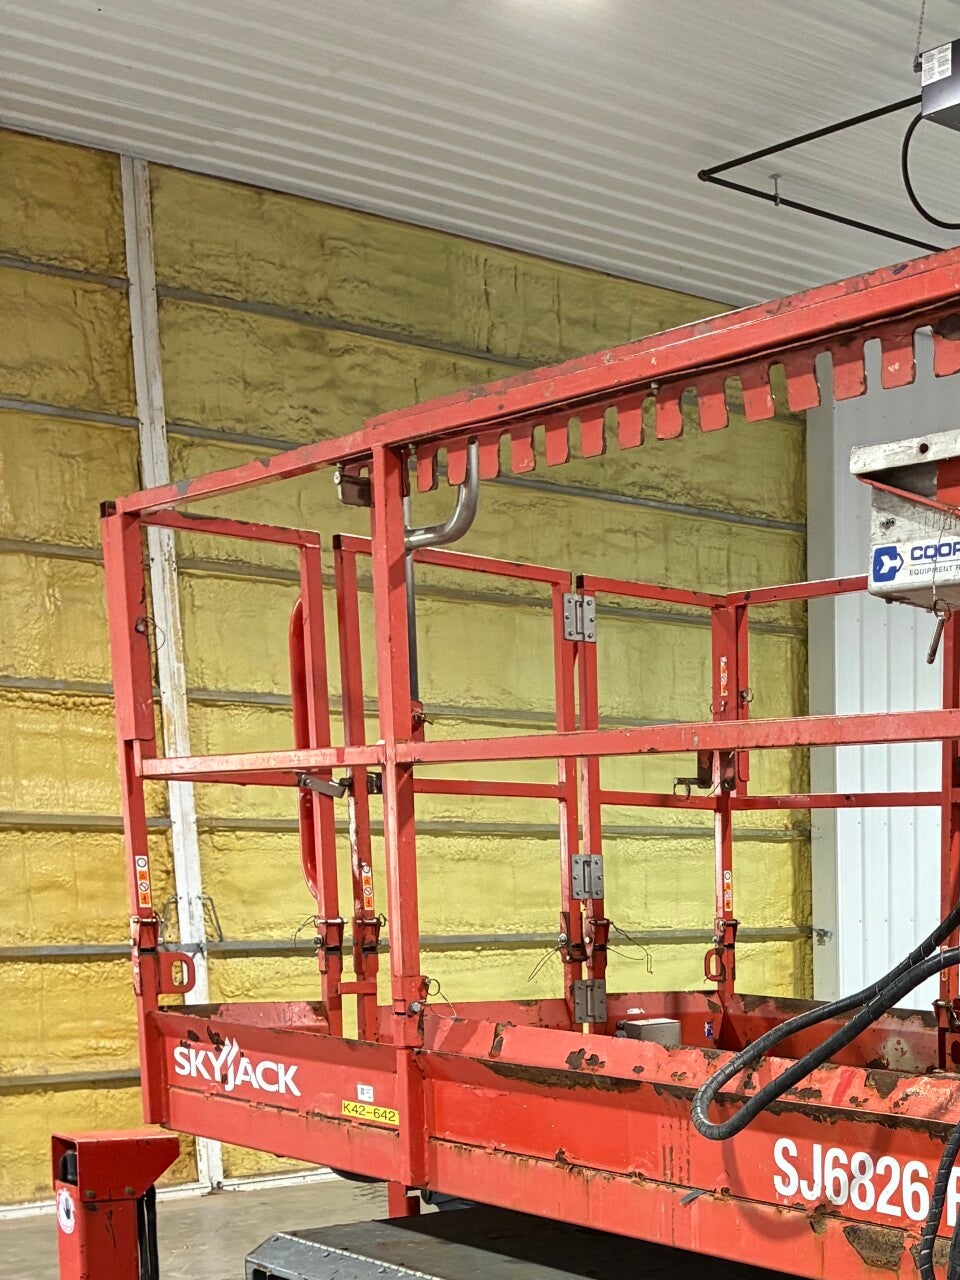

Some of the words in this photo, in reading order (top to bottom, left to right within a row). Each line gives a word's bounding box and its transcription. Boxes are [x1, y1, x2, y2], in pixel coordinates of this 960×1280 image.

[909, 565, 953, 577] EQUIPMENT
[173, 1037, 302, 1097] SKYJACK
[342, 1102, 397, 1122] K42-642
[773, 1137, 930, 1222] SJ6826
